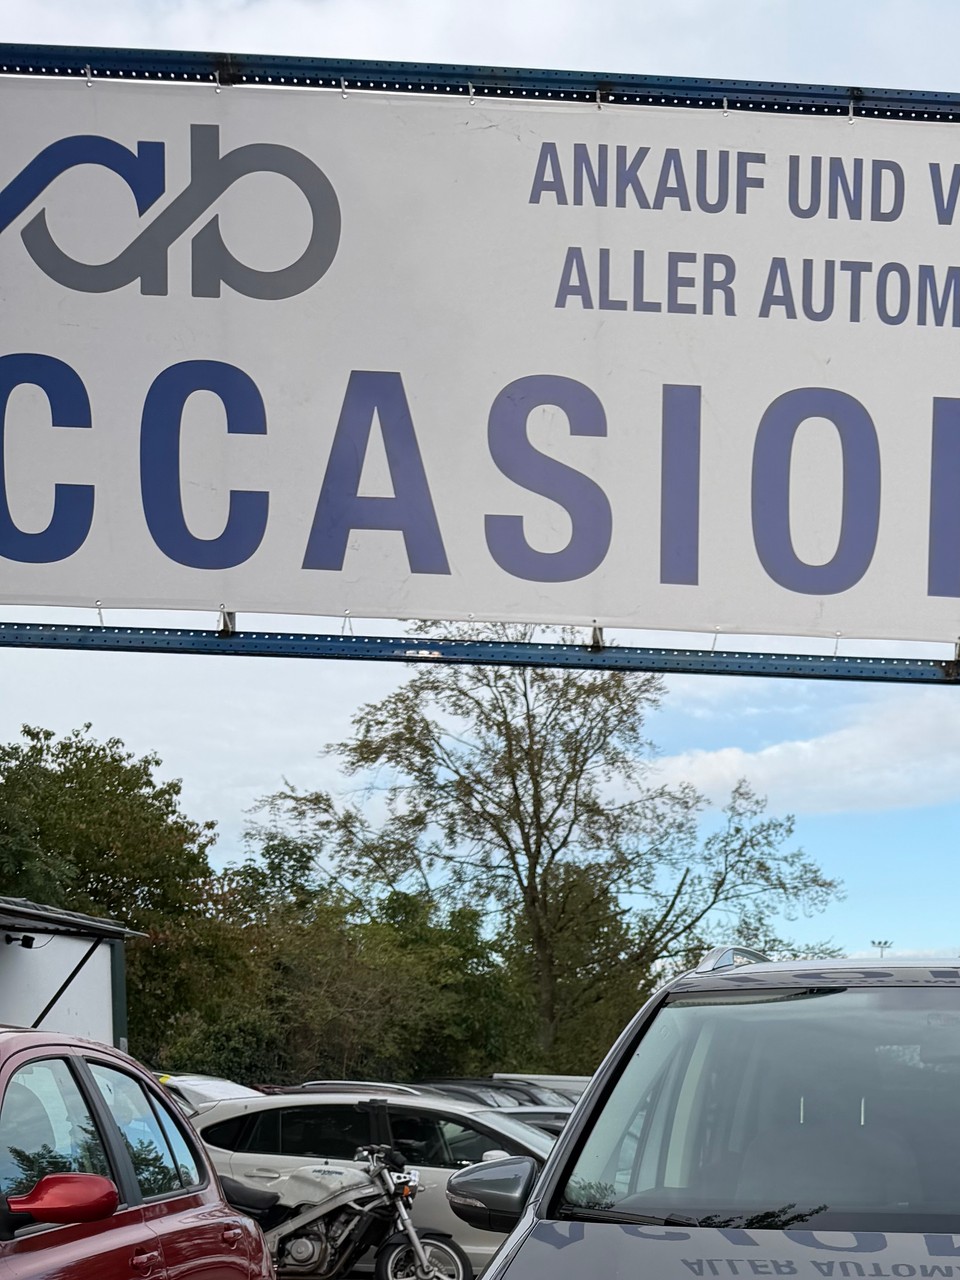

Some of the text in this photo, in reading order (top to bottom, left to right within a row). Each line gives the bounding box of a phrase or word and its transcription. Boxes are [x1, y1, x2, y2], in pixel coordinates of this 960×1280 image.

[529, 141, 767, 215] ANKAUF
[788, 154, 905, 223] UND
[555, 246, 737, 317] ALLER
